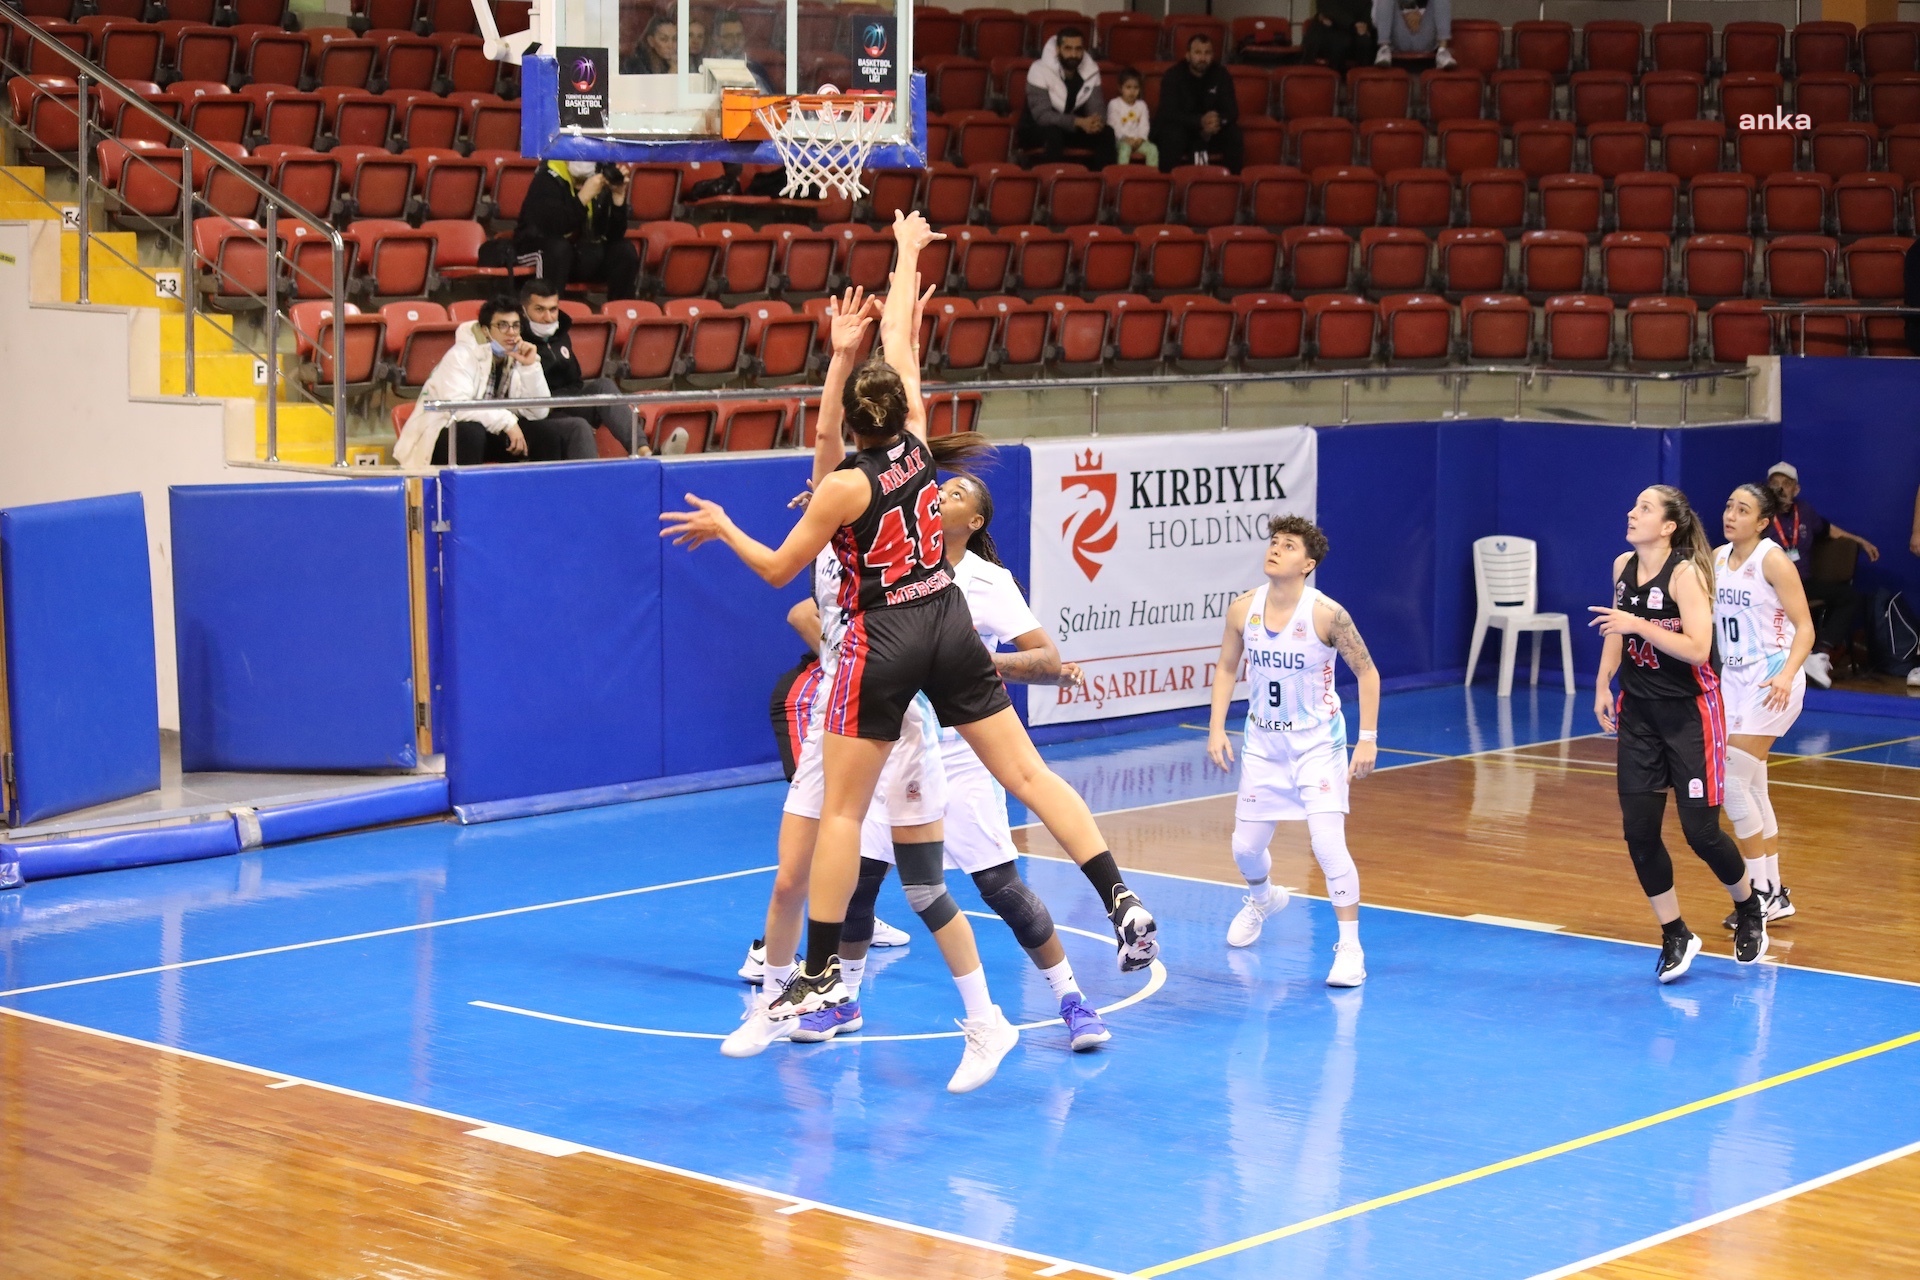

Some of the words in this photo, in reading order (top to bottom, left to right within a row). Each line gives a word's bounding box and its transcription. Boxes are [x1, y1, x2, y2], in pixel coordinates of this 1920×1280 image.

[858, 58, 892, 68] BASKETBOL
[565, 100, 602, 108] BASKETBOL
[159, 279, 177, 292] F3
[1130, 463, 1287, 509] KIRBIYIK
[864, 480, 943, 587] 46
[1058, 605, 1121, 642] Şahin
[1128, 600, 1194, 627] Harun
[1722, 616, 1739, 643] 10
[1248, 648, 1305, 670] TARSUS
[1056, 665, 1195, 709] BAŞARILAR
[1269, 681, 1281, 707] 9
